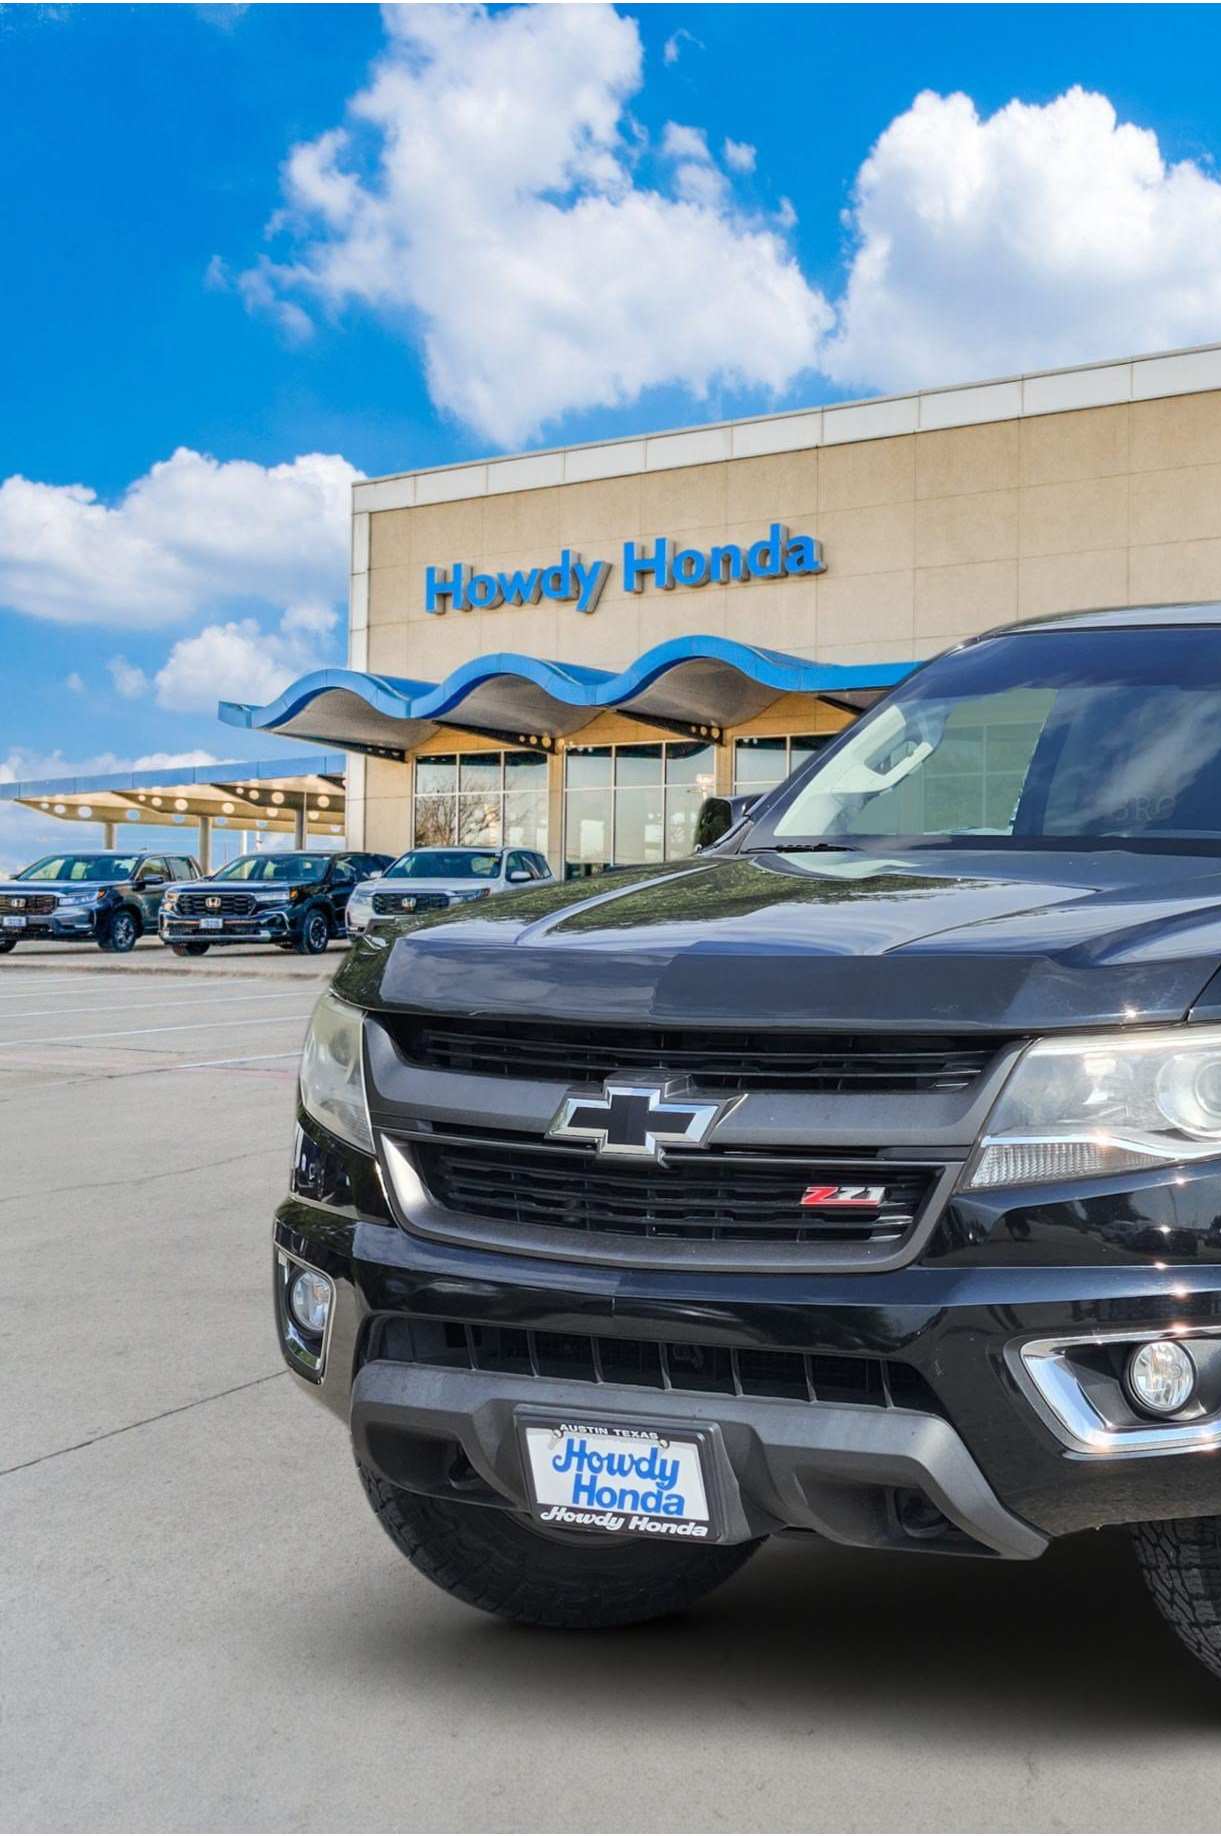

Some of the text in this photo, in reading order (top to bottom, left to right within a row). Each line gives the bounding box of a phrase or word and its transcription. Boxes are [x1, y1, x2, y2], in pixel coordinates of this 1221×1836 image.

[425, 522, 827, 616] Howdy Honda
[800, 1186, 886, 1207] Z71
[560, 1423, 659, 1441] AUSTIN TEXAS
[553, 1439, 680, 1490] Howdy
[573, 1473, 685, 1515] Honda
[540, 1506, 709, 1537] Howdy Honda
